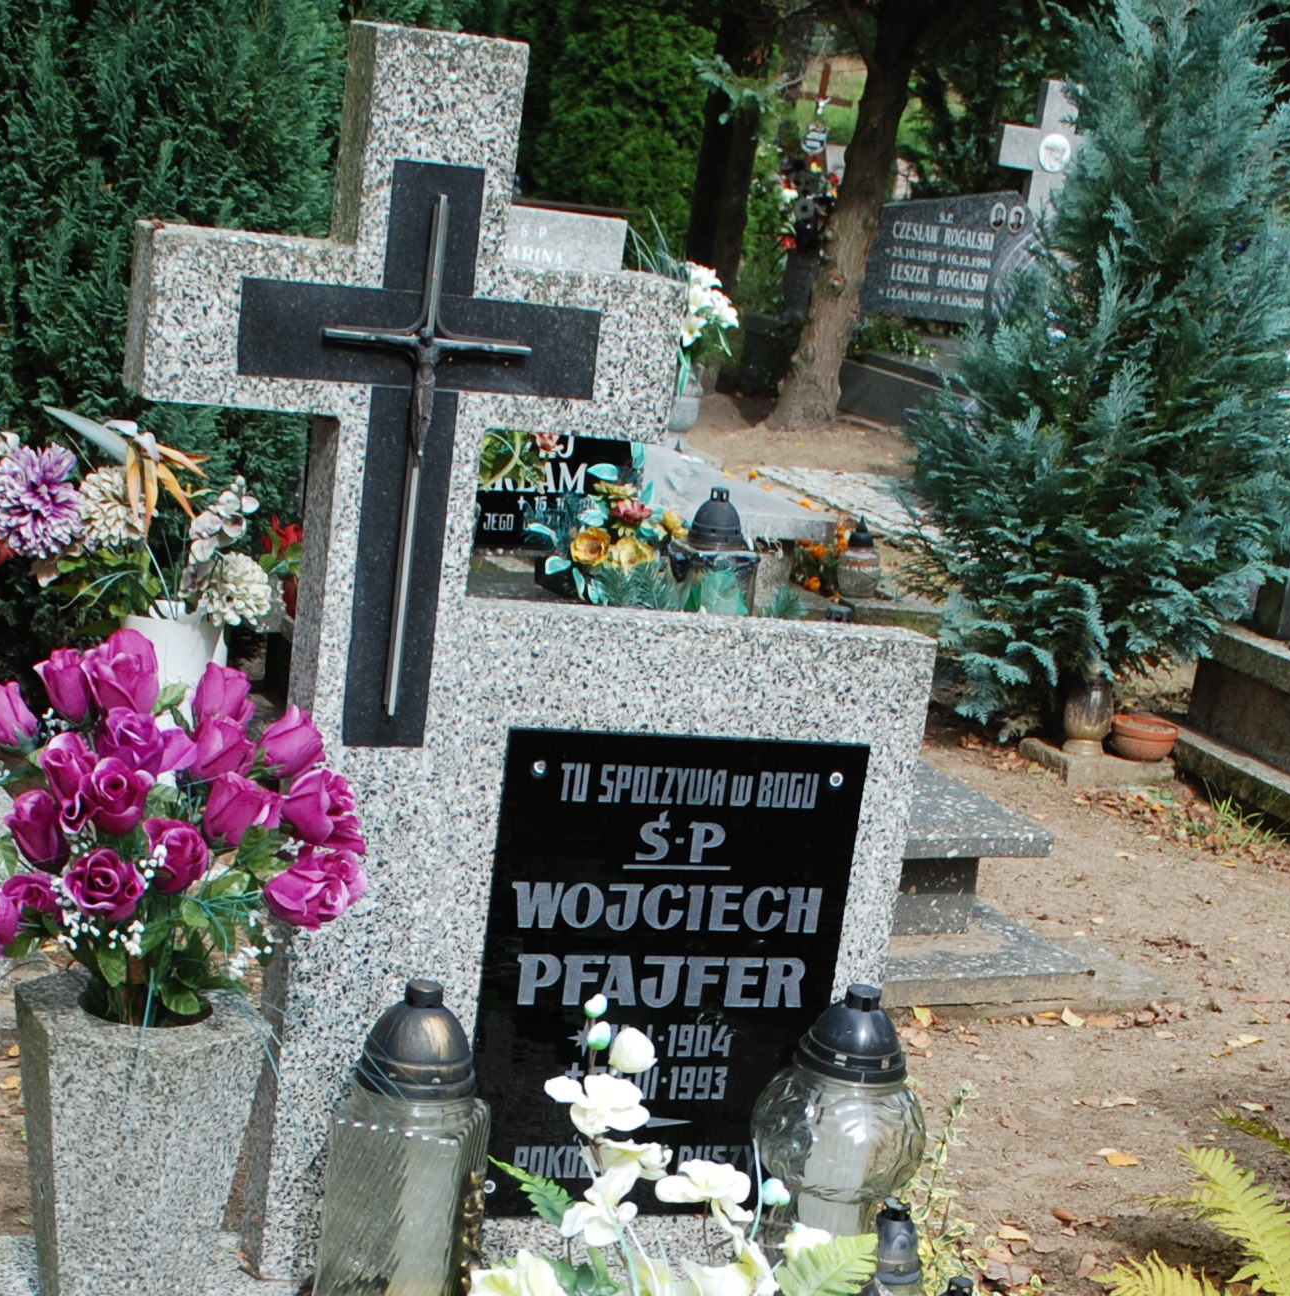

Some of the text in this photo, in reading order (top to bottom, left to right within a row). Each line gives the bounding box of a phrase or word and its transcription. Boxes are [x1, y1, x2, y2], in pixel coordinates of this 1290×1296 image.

[504, 245, 564, 265] ARINA
[943, 228, 996, 251] ROGALSKI
[890, 262, 989, 292] LESZEK ROGALSKI
[560, 762, 591, 802] TU
[597, 764, 728, 807] SPOCZYWA
[756, 771, 820, 810] BOGU
[512, 881, 824, 935] WOJCIECH
[516, 953, 807, 1009] PFAJFER
